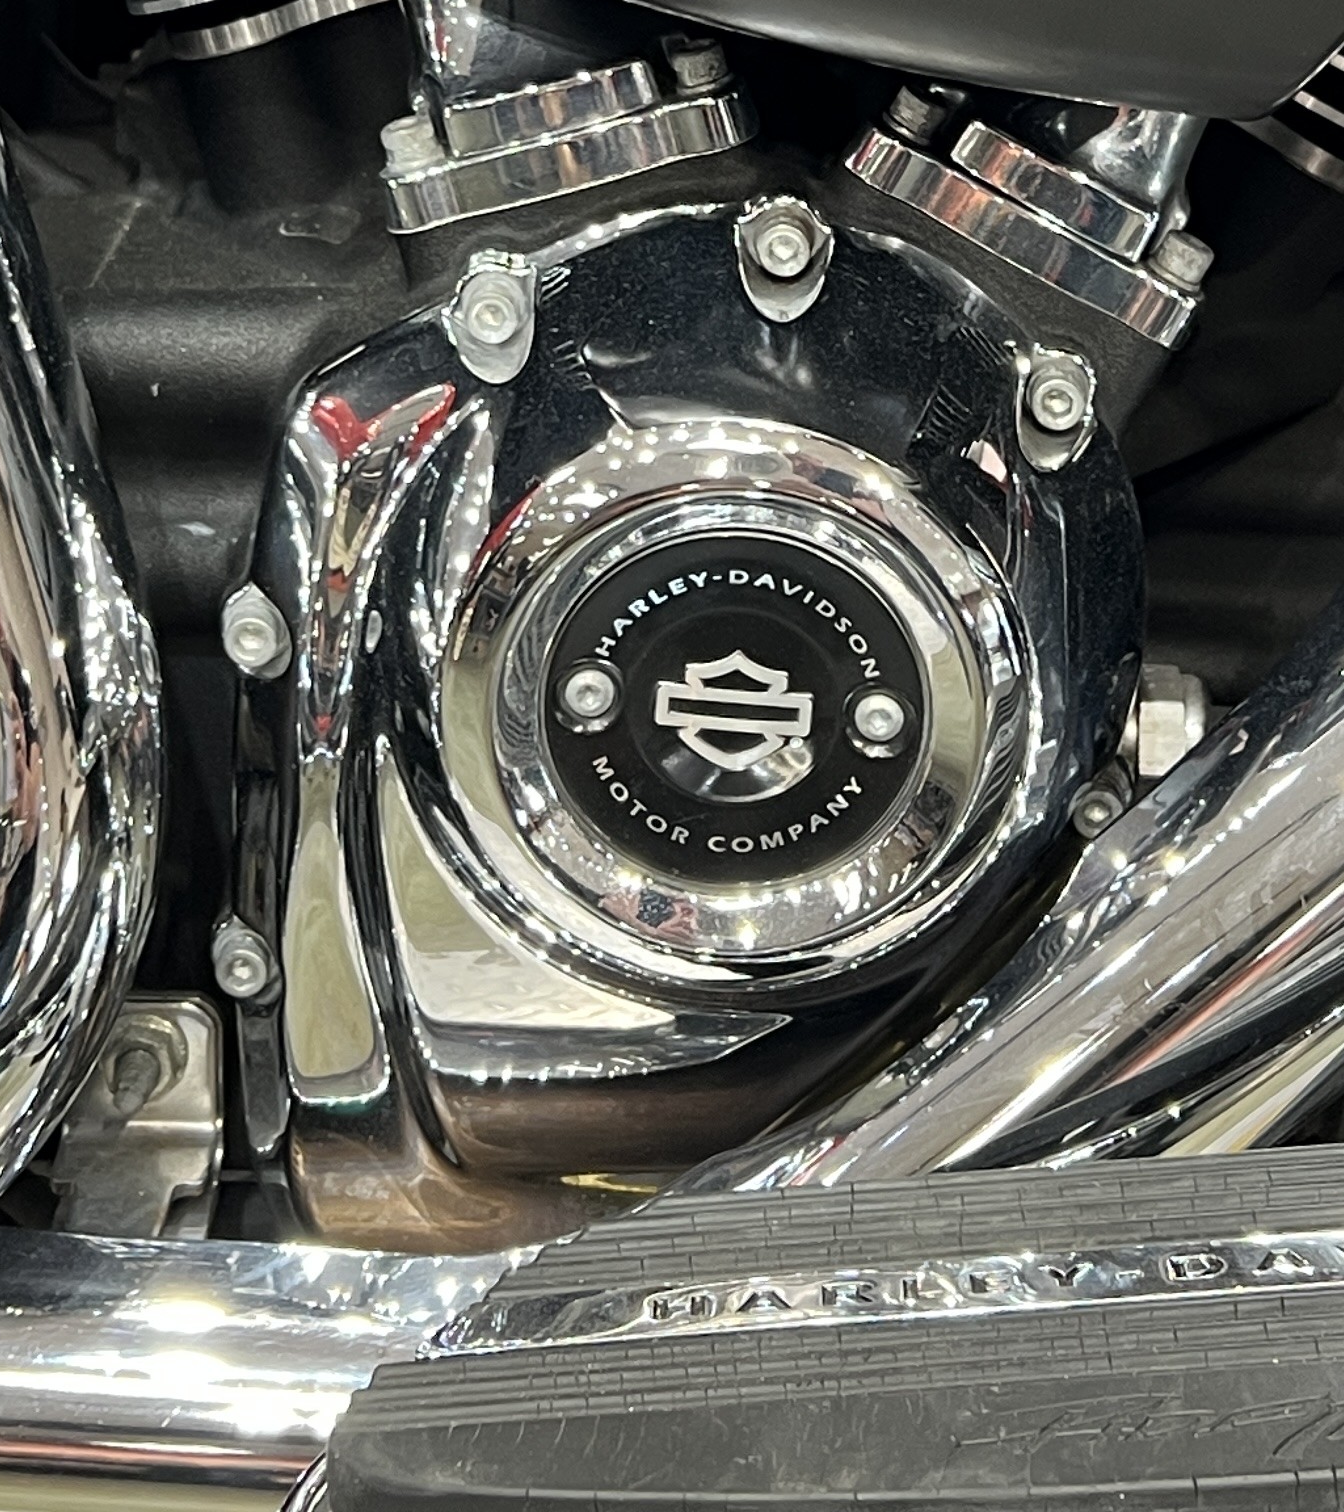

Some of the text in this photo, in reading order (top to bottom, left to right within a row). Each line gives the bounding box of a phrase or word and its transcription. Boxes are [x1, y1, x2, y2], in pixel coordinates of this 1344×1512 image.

[594, 569, 881, 680] HARLEY-DAVIDSON
[592, 755, 863, 853] MOTOR COMPANY
